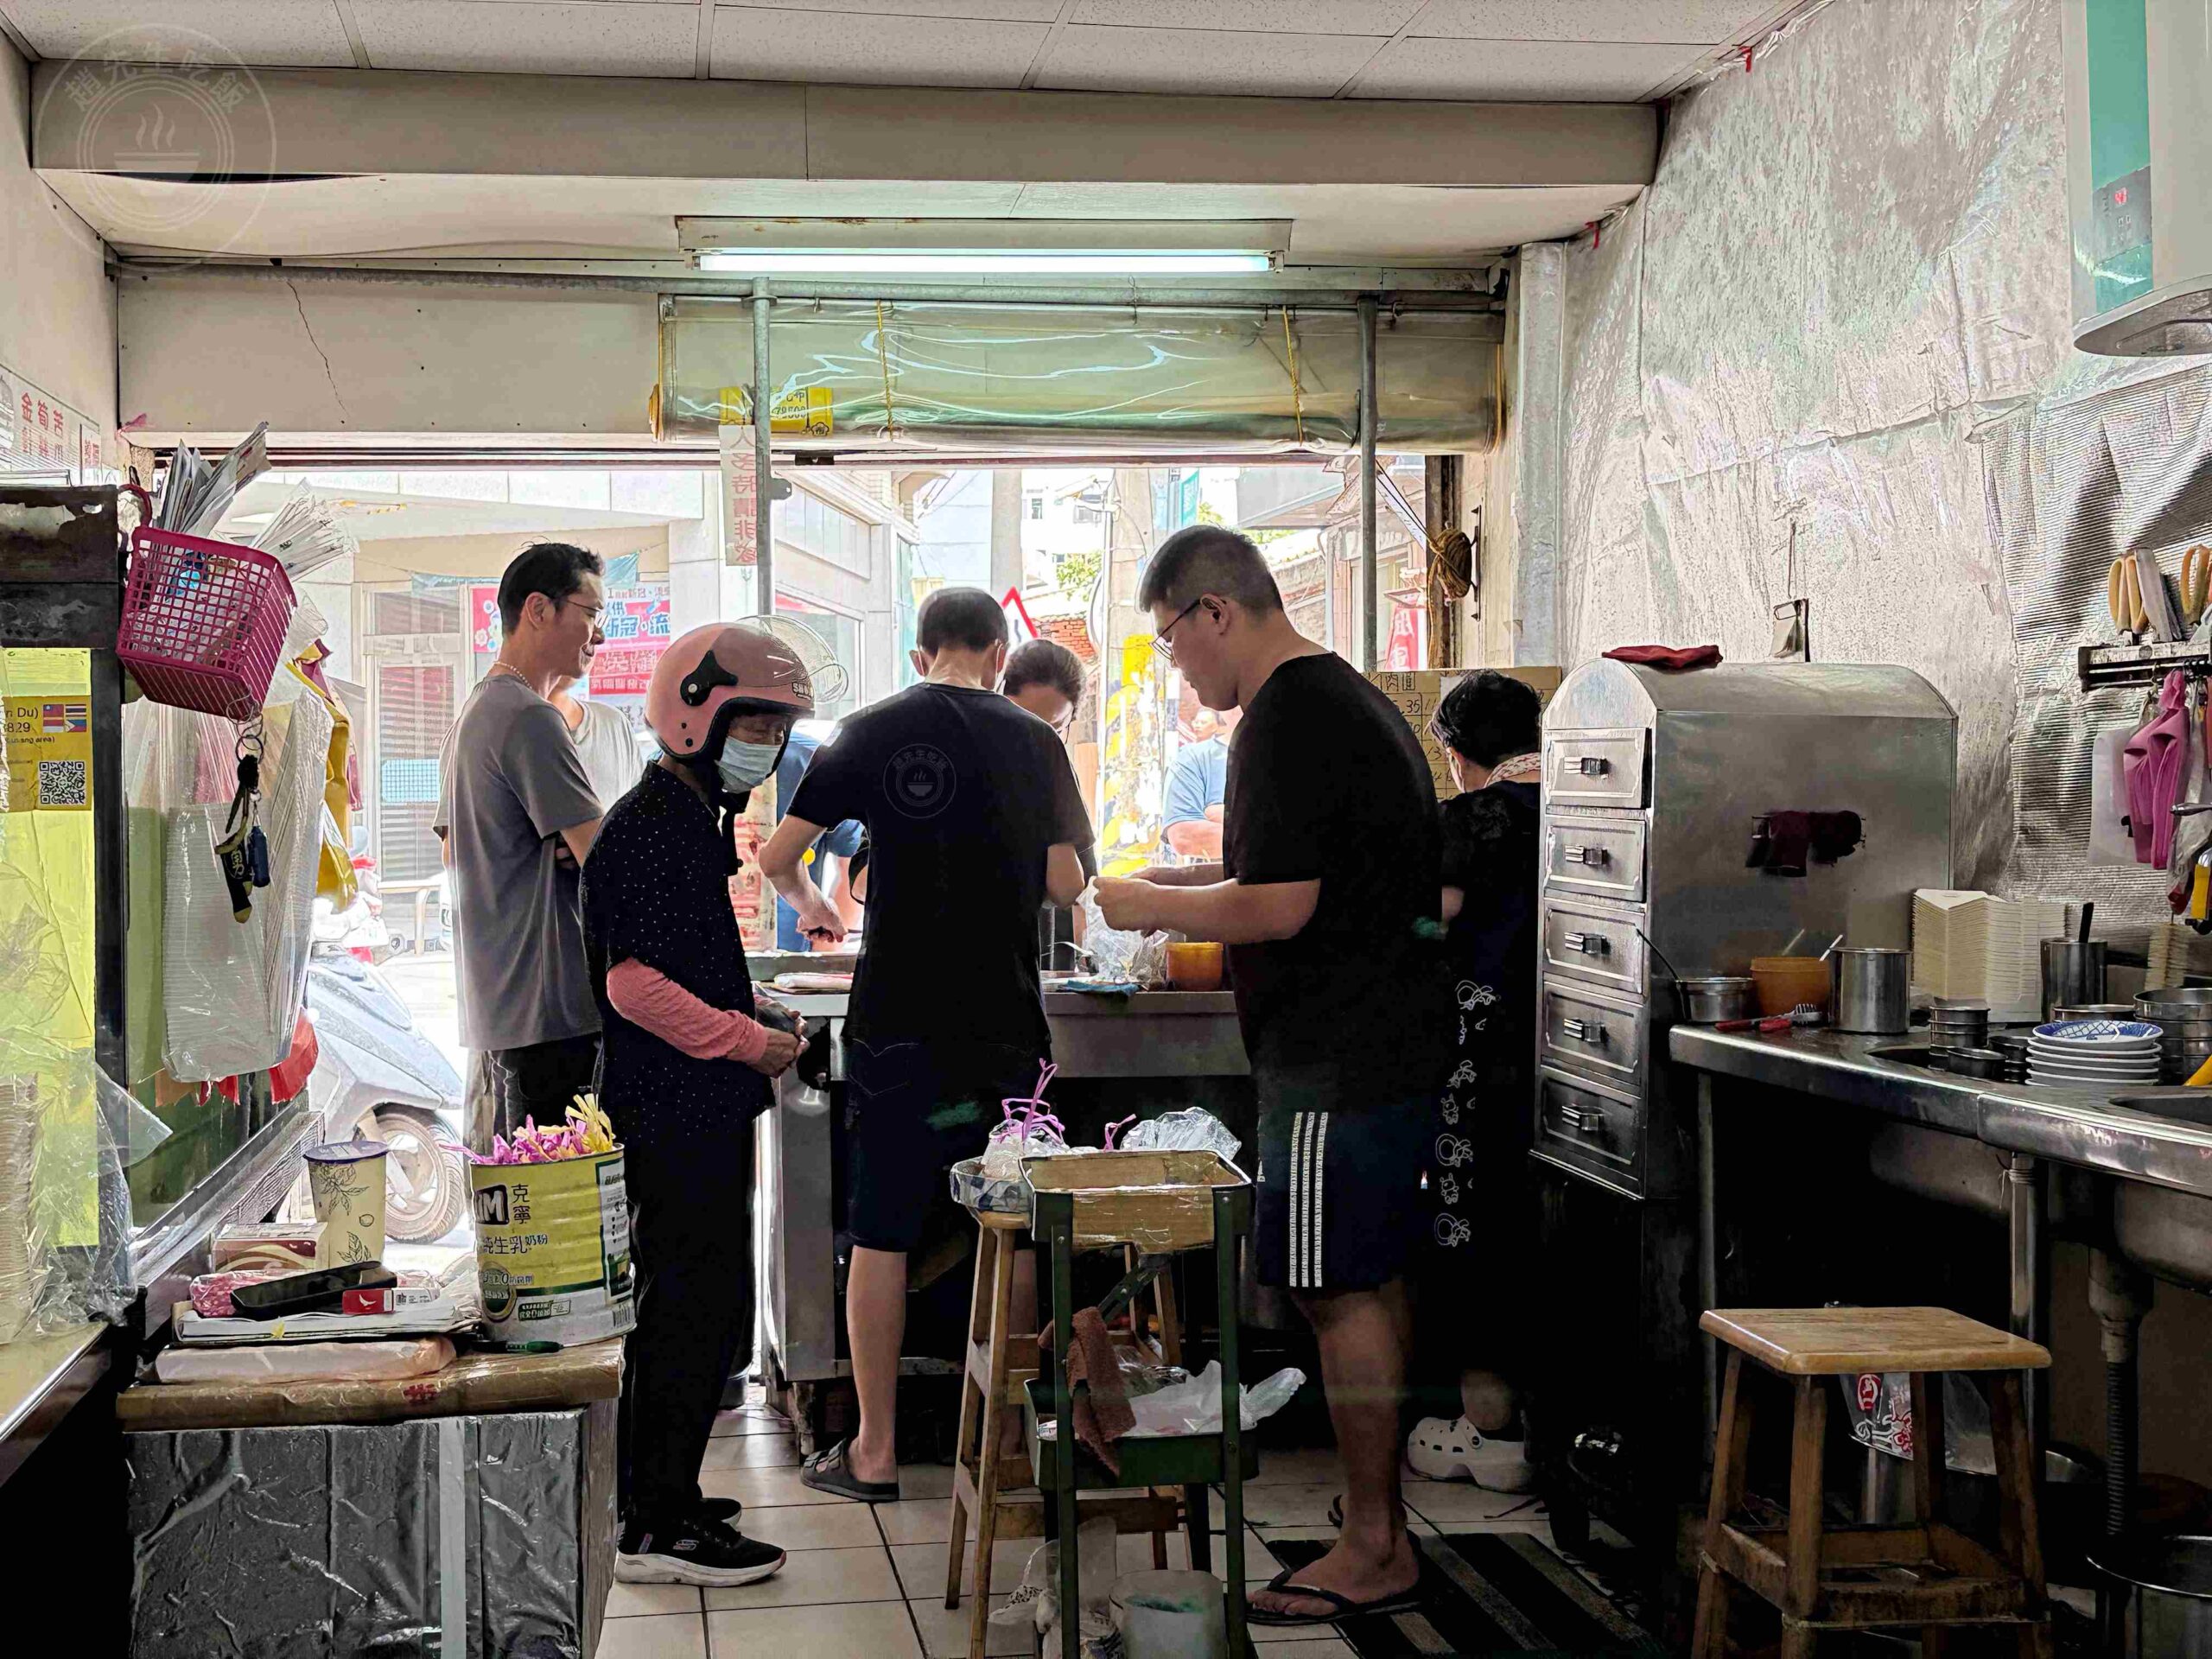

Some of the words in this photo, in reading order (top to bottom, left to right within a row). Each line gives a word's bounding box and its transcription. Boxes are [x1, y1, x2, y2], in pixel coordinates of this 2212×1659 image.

[17, 707, 39, 719] Du)
[475, 1190, 505, 1221] IM
[512, 1183, 531, 1224] 克寧
